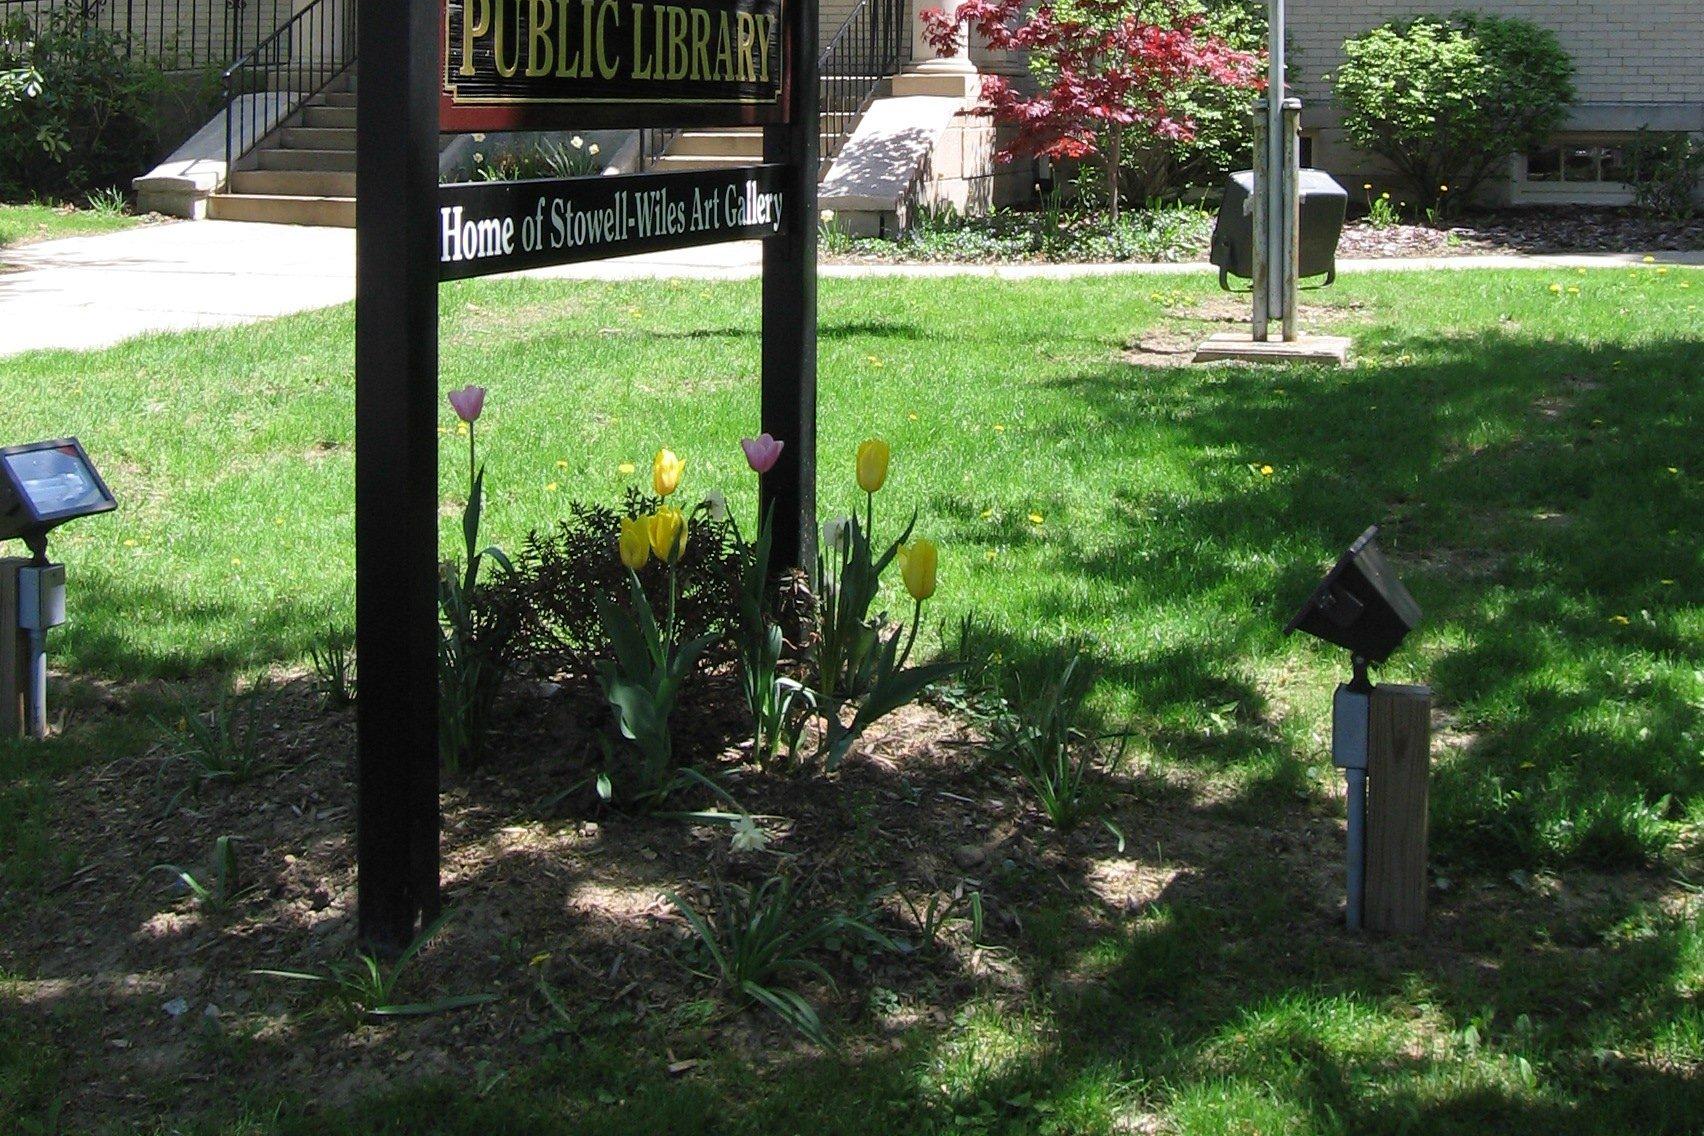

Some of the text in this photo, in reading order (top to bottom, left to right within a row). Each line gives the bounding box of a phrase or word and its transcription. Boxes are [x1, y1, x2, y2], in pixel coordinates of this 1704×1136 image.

[630, 2, 779, 83] LIBRARY
[440, 179, 783, 262] Home of Stowell-Wiles Art Gallery
